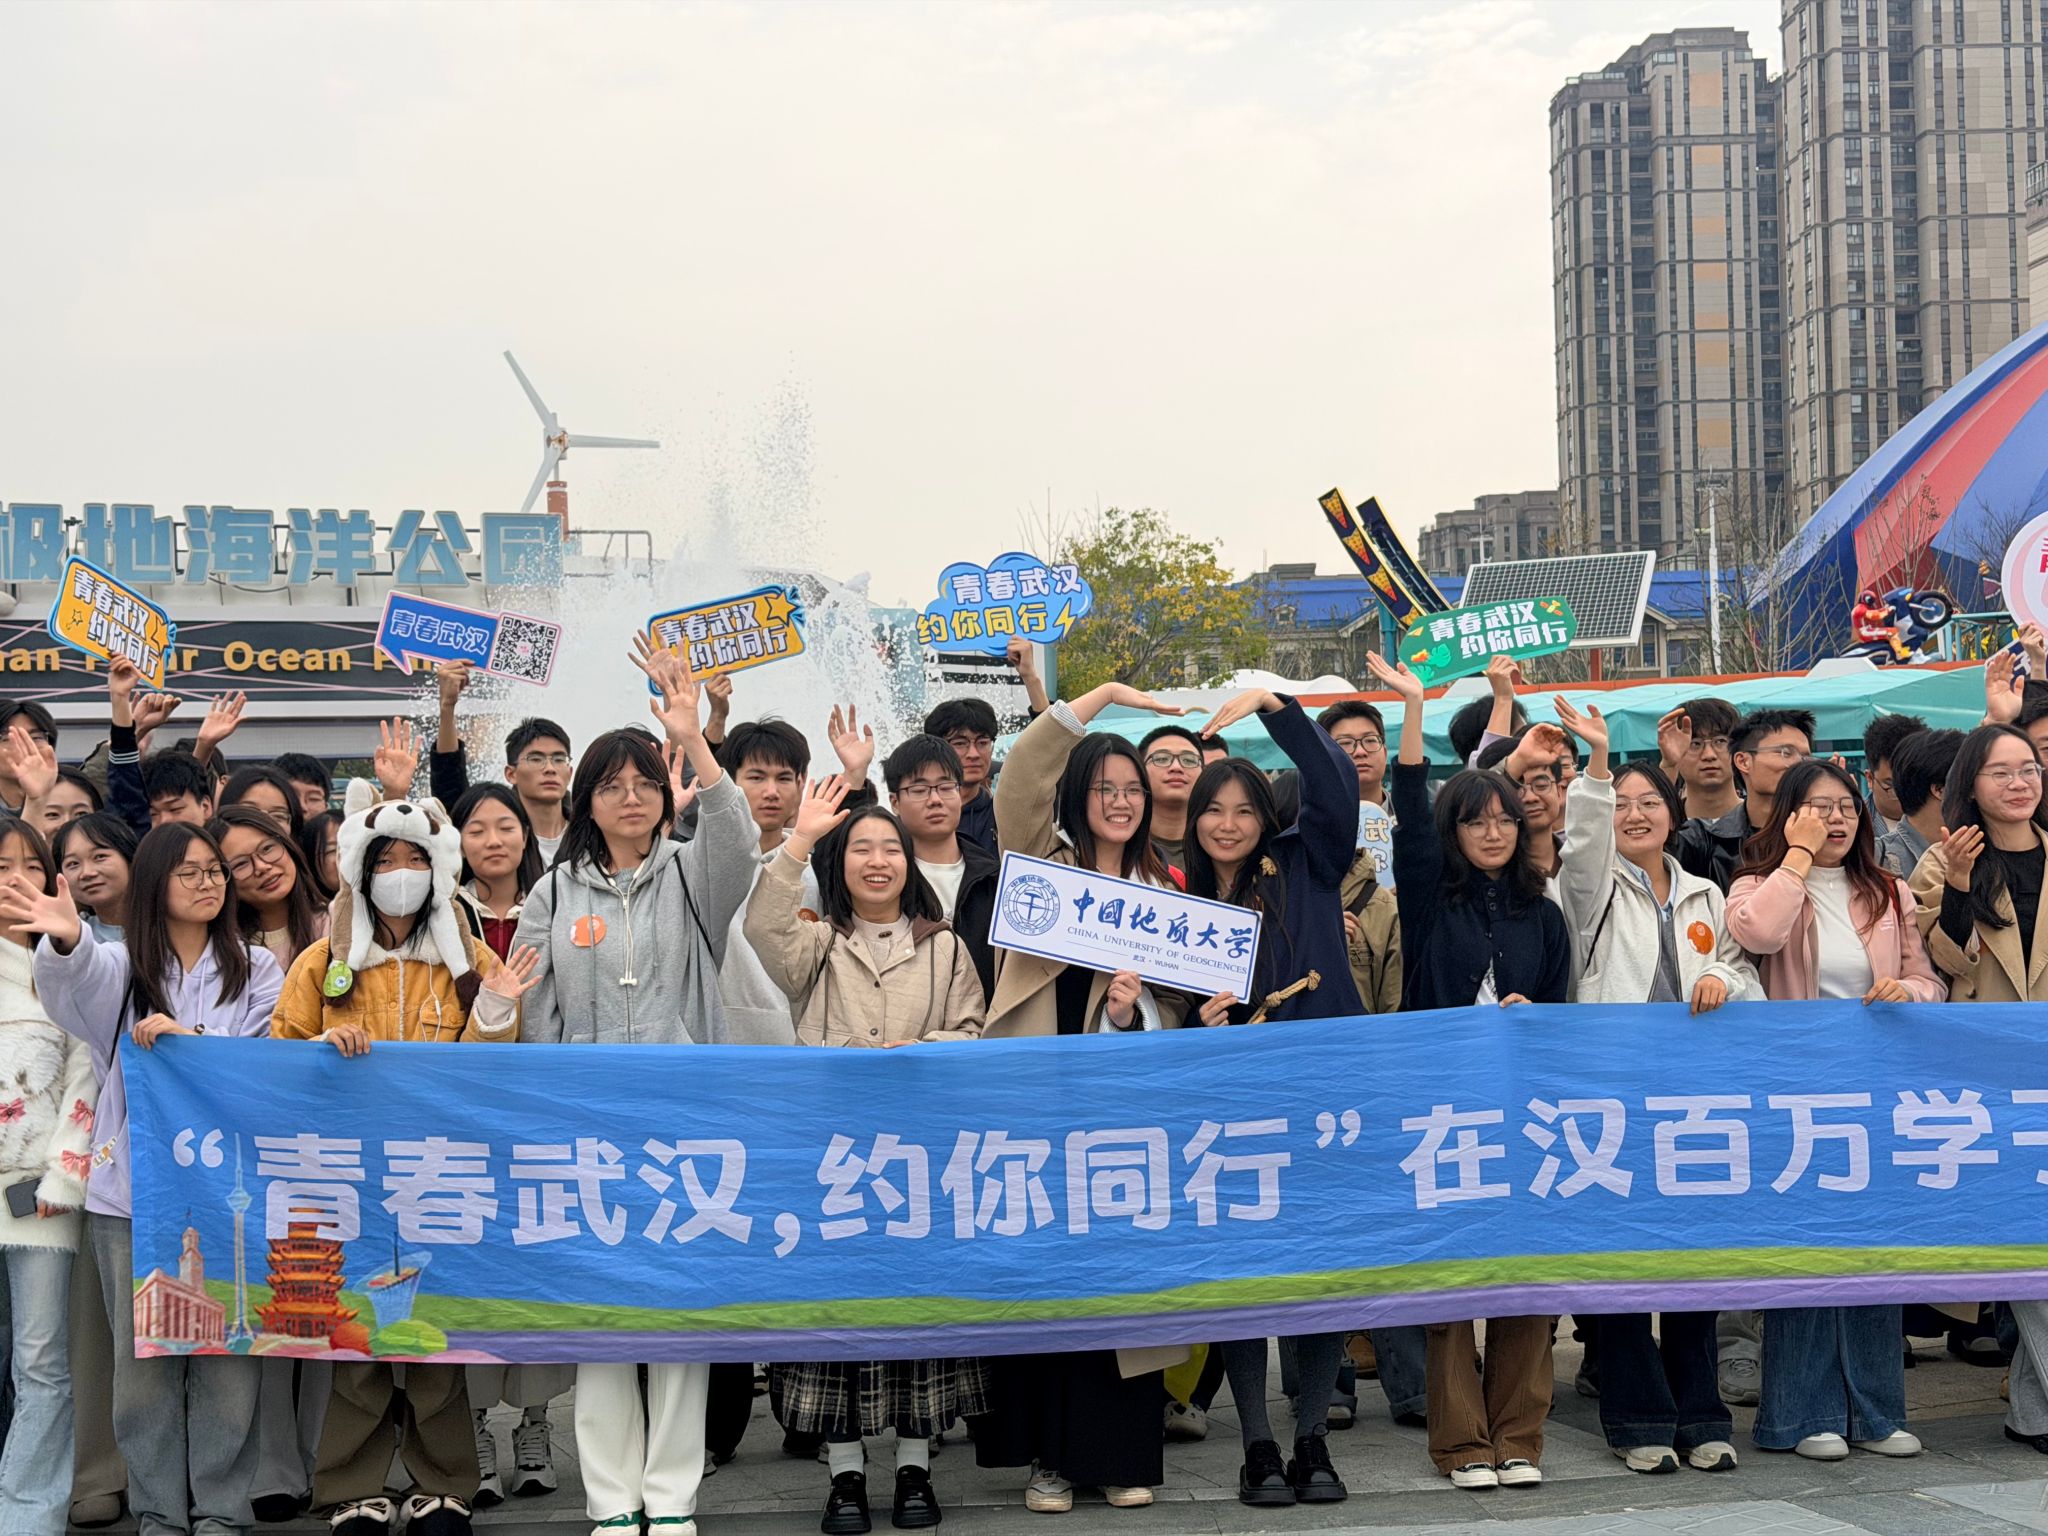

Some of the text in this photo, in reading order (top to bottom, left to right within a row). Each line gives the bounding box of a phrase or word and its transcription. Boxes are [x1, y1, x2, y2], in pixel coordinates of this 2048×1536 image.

[0, 503, 563, 587] 极地海洋公园
[74, 568, 149, 639] 青春武汉
[952, 564, 1083, 604] 青春武汉
[390, 609, 489, 655] 青春武汉
[657, 601, 761, 648] 青春武汉
[916, 602, 1047, 645] 约你同行
[1429, 602, 1537, 642] 青春武汉
[1460, 621, 1567, 659] 约你同行
[0, 648, 60, 672] an
[224, 641, 351, 672] Ocean
[87, 611, 160, 679] 约你同行
[689, 625, 787, 672] 约你同行
[1358, 818, 1389, 844] 武
[1067, 926, 1247, 975] CHINA UNIVERSITY OF GEOSCIENCES
[1155, 959, 1179, 970] WUHAN
